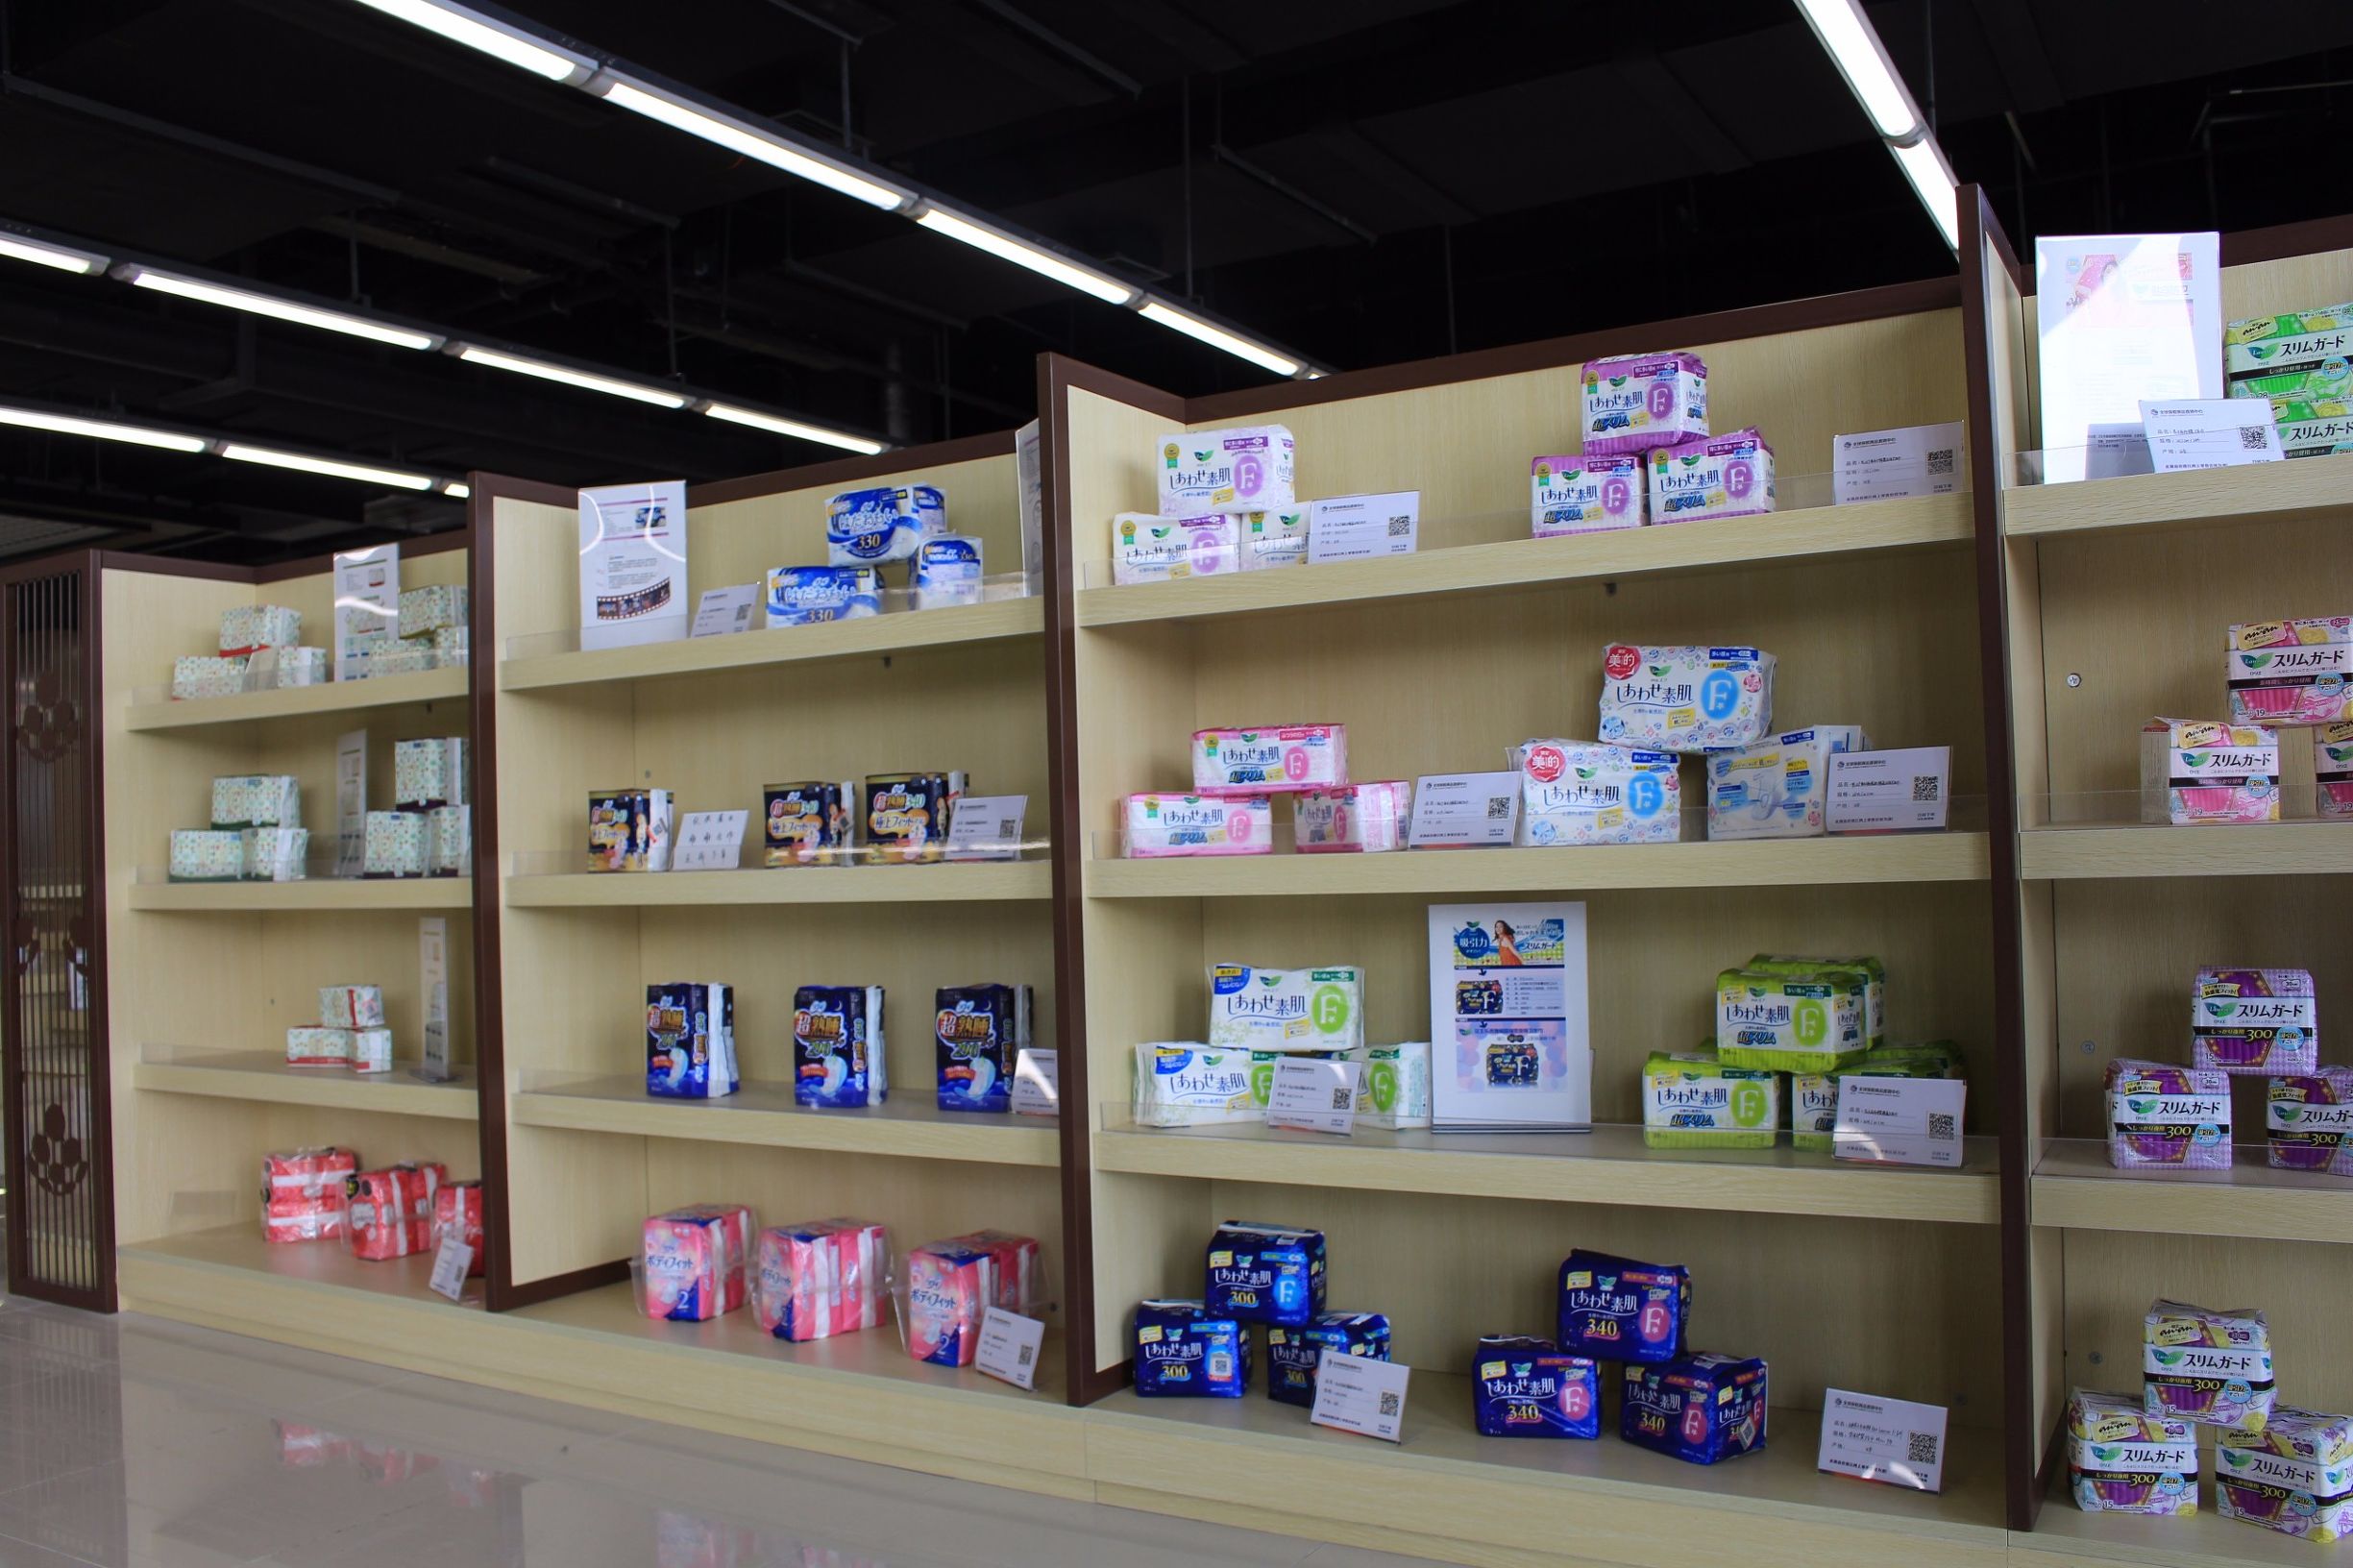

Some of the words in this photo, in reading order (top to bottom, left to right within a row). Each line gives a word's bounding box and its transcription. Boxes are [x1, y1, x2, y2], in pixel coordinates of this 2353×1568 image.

[2280, 335, 2345, 357] スリムガード
[1590, 390, 1643, 413] しあわせ素肌
[1653, 387, 1669, 413] F
[1170, 467, 1231, 488] しあわせ素肌
[1660, 470, 1720, 493] しあわせ素肌
[1730, 467, 1747, 492] F
[1541, 484, 1598, 503] しあわせ素肌
[1607, 483, 1624, 508] F
[857, 533, 881, 550] 330
[807, 608, 834, 622] 330
[1608, 653, 1635, 668] 美的
[2271, 649, 2344, 669] スリムガード
[1617, 683, 1693, 704] しあわせ素肌
[1708, 678, 1732, 711] F
[1223, 746, 1280, 765] しあわせ素肌
[1532, 755, 1559, 769] 美的
[2210, 753, 2271, 768] スリムガード
[1543, 785, 1621, 805] しあわせ素肌
[1635, 780, 1654, 810] F
[1164, 808, 1223, 828] しあわせ素肌
[1227, 994, 1307, 1016] しあわせ素肌
[1319, 993, 1341, 1024] F
[1727, 1003, 1791, 1023] しあわせ素肌
[2238, 1004, 2303, 1018] スリムガード
[1800, 1007, 1819, 1039] F
[2245, 1029, 2273, 1042] 300
[1170, 1072, 1247, 1093] しあわせ素肌
[1657, 1087, 1728, 1106] しあわせ素肌
[2159, 1101, 2220, 1115] スリムガード
[2166, 1125, 2192, 1139] 300
[2310, 1133, 2337, 1146] 300
[1214, 1269, 1272, 1285] しあわせ素肌
[677, 1291, 690, 1310] 2
[1231, 1290, 1257, 1306] 300
[1570, 1291, 1637, 1313] しあわせ素肌
[1586, 1318, 1618, 1336] 340
[1644, 1307, 1665, 1335] F
[936, 1335, 950, 1356] 2
[1145, 1342, 1202, 1360] しあわせ素肌
[2186, 1353, 2252, 1369] スリムガード
[1162, 1364, 1189, 1379] 300
[1487, 1377, 1556, 1398] しあわせ素肌
[2193, 1379, 2220, 1392] 300
[1629, 1383, 1681, 1411] しあわせ素肌
[1507, 1404, 1538, 1420] 340
[1639, 1412, 1666, 1433] 340
[2123, 1448, 2184, 1464] スリムガード
[2130, 1474, 2155, 1486] 300
[2253, 1458, 2316, 1484] スリムガード
[2260, 1484, 2286, 1500] 300
